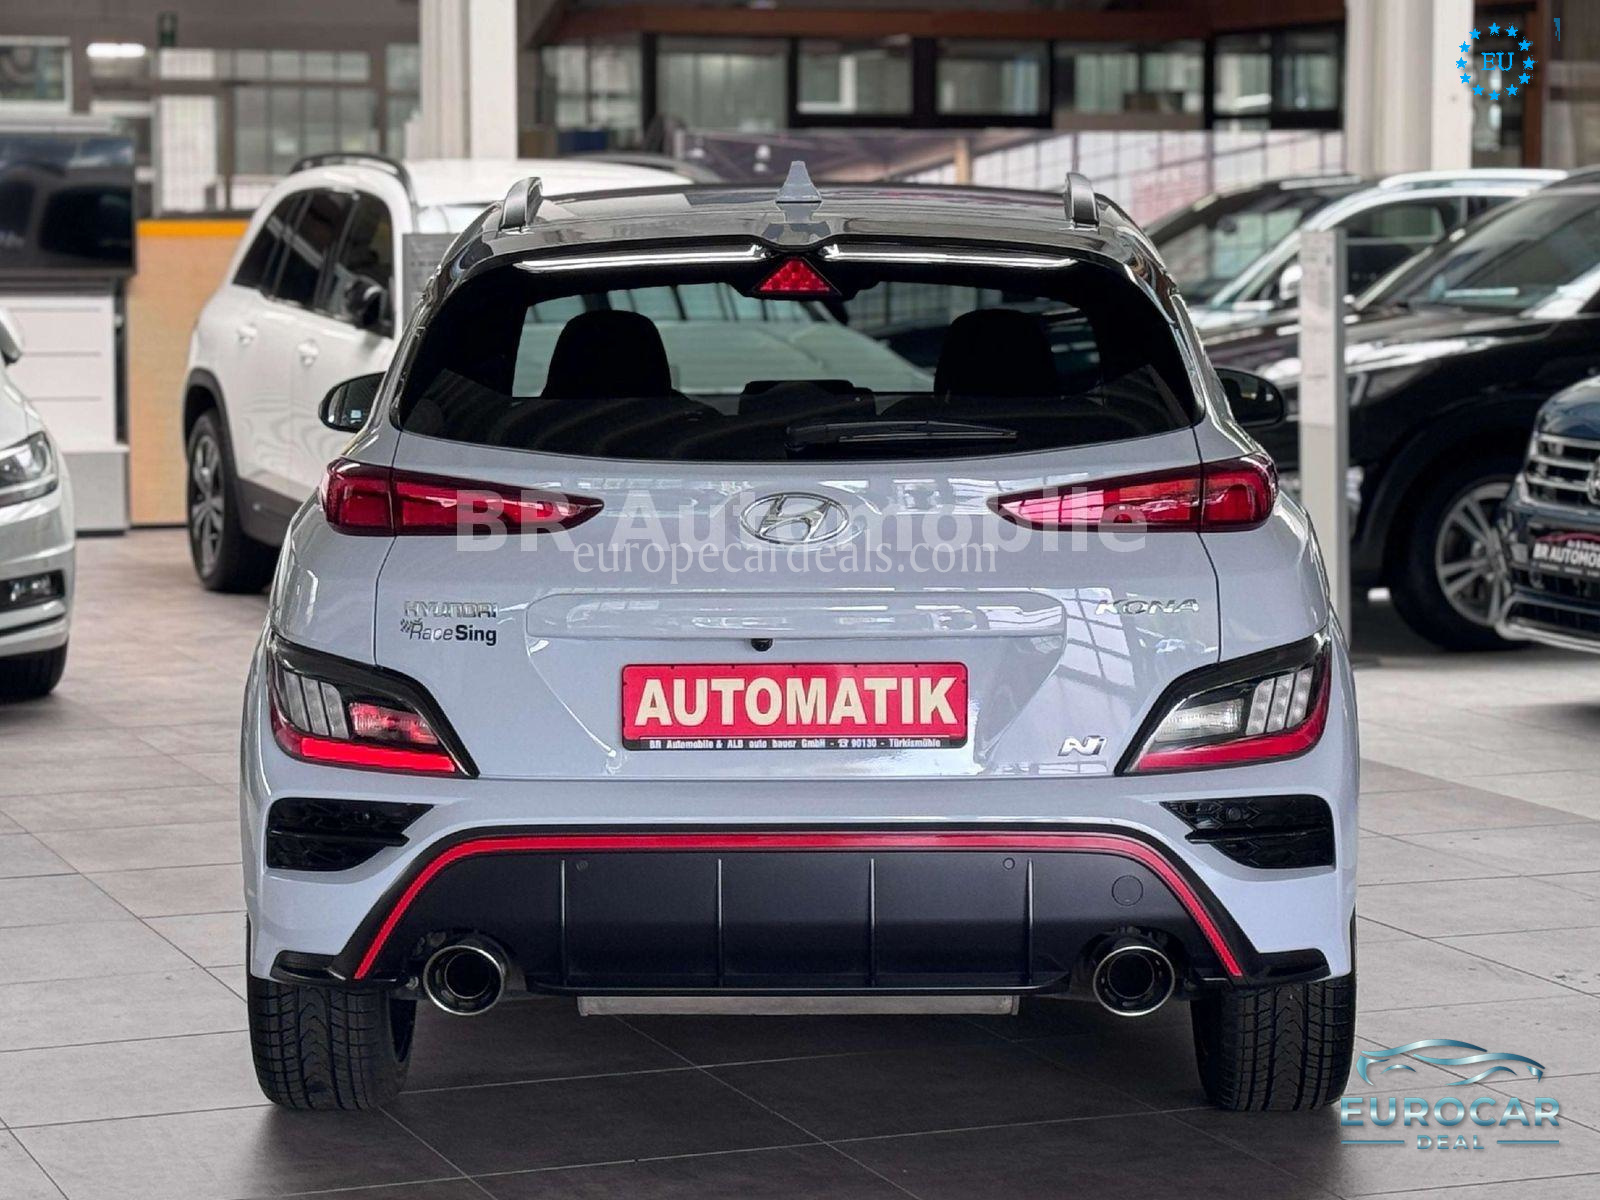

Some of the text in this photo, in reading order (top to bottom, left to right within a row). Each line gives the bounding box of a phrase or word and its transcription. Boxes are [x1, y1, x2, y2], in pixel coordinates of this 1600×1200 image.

[404, 601, 499, 618] HYUNDAI
[1096, 599, 1199, 615] KONA
[634, 677, 958, 726] AUTOMATIK
[649, 740, 661, 749] BR
[666, 740, 714, 749] Automobile
[801, 739, 826, 748] GmbH
